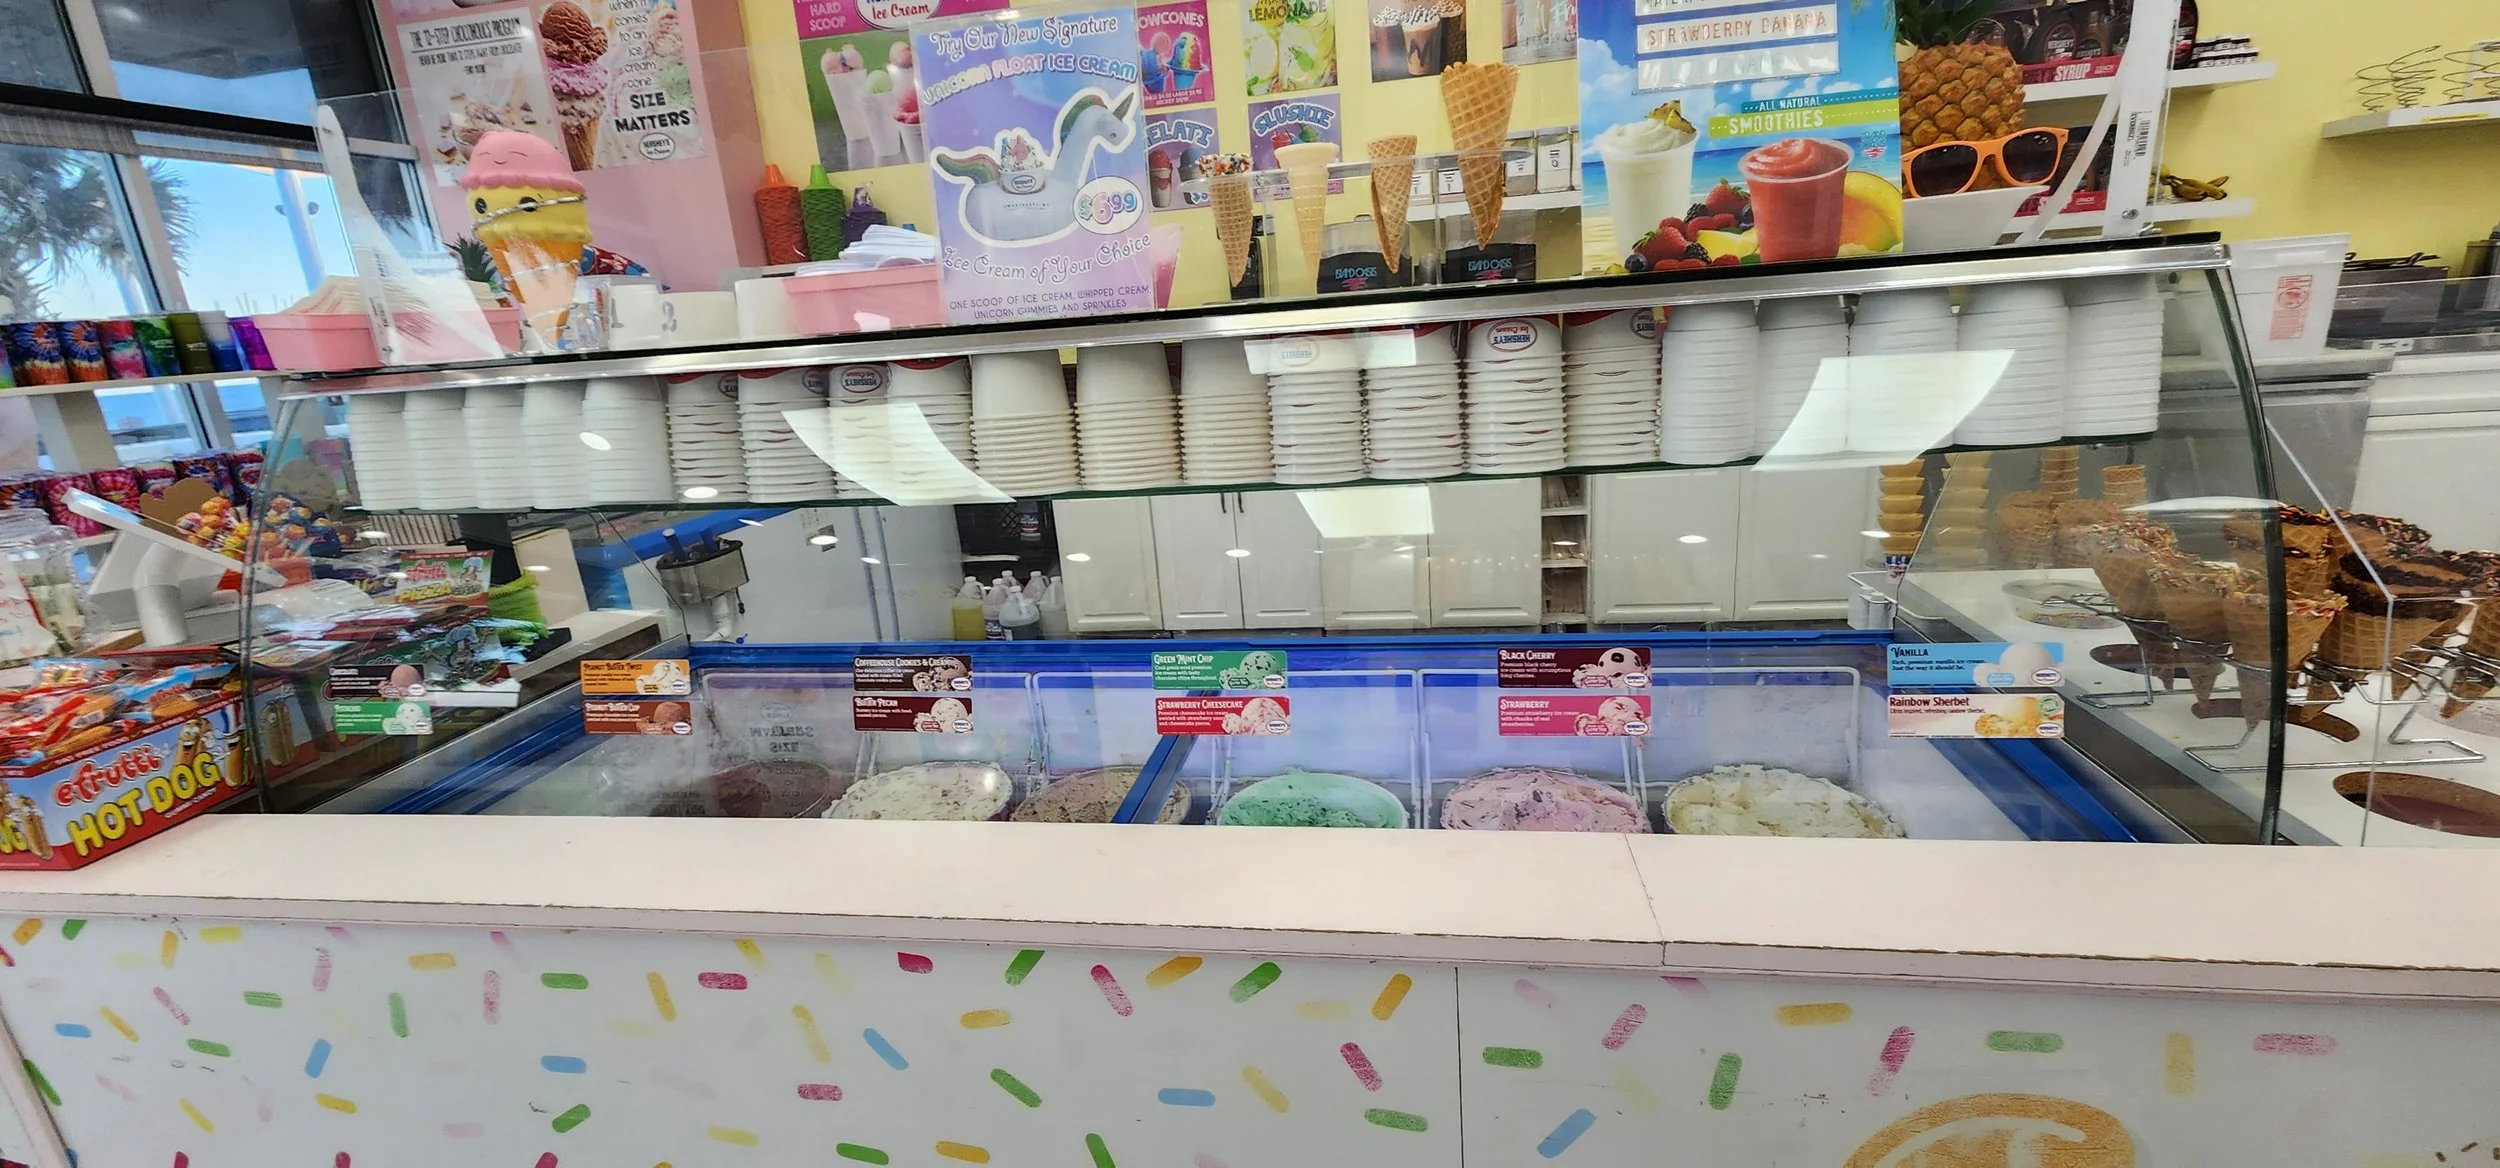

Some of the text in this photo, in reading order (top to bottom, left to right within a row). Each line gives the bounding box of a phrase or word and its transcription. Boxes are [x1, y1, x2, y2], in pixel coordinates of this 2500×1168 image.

[809, 2, 841, 17] HARD
[872, 3, 931, 20] Ice Cream
[1248, 2, 1327, 22] LEMONADE
[614, 13, 649, 27] comes
[809, 16, 846, 32] SCOOP
[1138, 12, 1205, 30] OWCONES
[618, 30, 647, 42] to an
[931, 17, 1117, 61] Try Our New Signature
[628, 46, 643, 57] ice
[624, 60, 657, 73] cream
[2054, 63, 2092, 82] SYRUP
[923, 54, 1138, 105] UNICORN FLOAT ICE CREAM
[629, 91, 666, 110] SIZE
[1759, 96, 1822, 112] ALL NATURAL
[614, 110, 691, 133] MATTERS
[1255, 103, 1334, 135] SLUSHIE
[1729, 110, 1824, 135] SMOOTHIES
[1146, 120, 1214, 148] ELATI
[943, 234, 1151, 284] Ice Cream of Your Choice
[950, 285, 1151, 311] ONE SCOOP OF ICE CREAM, WHIPPED CREAM,
[611, 298, 625, 329] 1
[974, 299, 1127, 320] UNICORN GUMMIES AND SPRINKLES
[1496, 325, 1529, 334] Ice Cream
[1492, 334, 1531, 346] HERSHEY'S
[845, 378, 877, 387] HERSHEY'S
[399, 580, 451, 601] PIZZA
[1154, 653, 1214, 665] GREEN MINT CHIP
[1499, 649, 1556, 660] BLACK CHERRY
[1891, 646, 1929, 658] VANILLA
[583, 662, 604, 672] PEANUT
[606, 662, 625, 671] BUTTER
[854, 657, 895, 667] COFFEEHOUSE
[895, 657, 921, 667] COOKIES
[922, 658, 928, 667] &
[855, 697, 898, 707] BUTTER PECAN
[1158, 699, 1244, 710] STRAWBERRY CHEESECAKE
[1499, 699, 1550, 710] STRAWBERRY
[1890, 696, 1970, 707] Rainbow Sherbet
[55, 743, 163, 807] efrutti
[67, 751, 222, 857] HOT DOG
